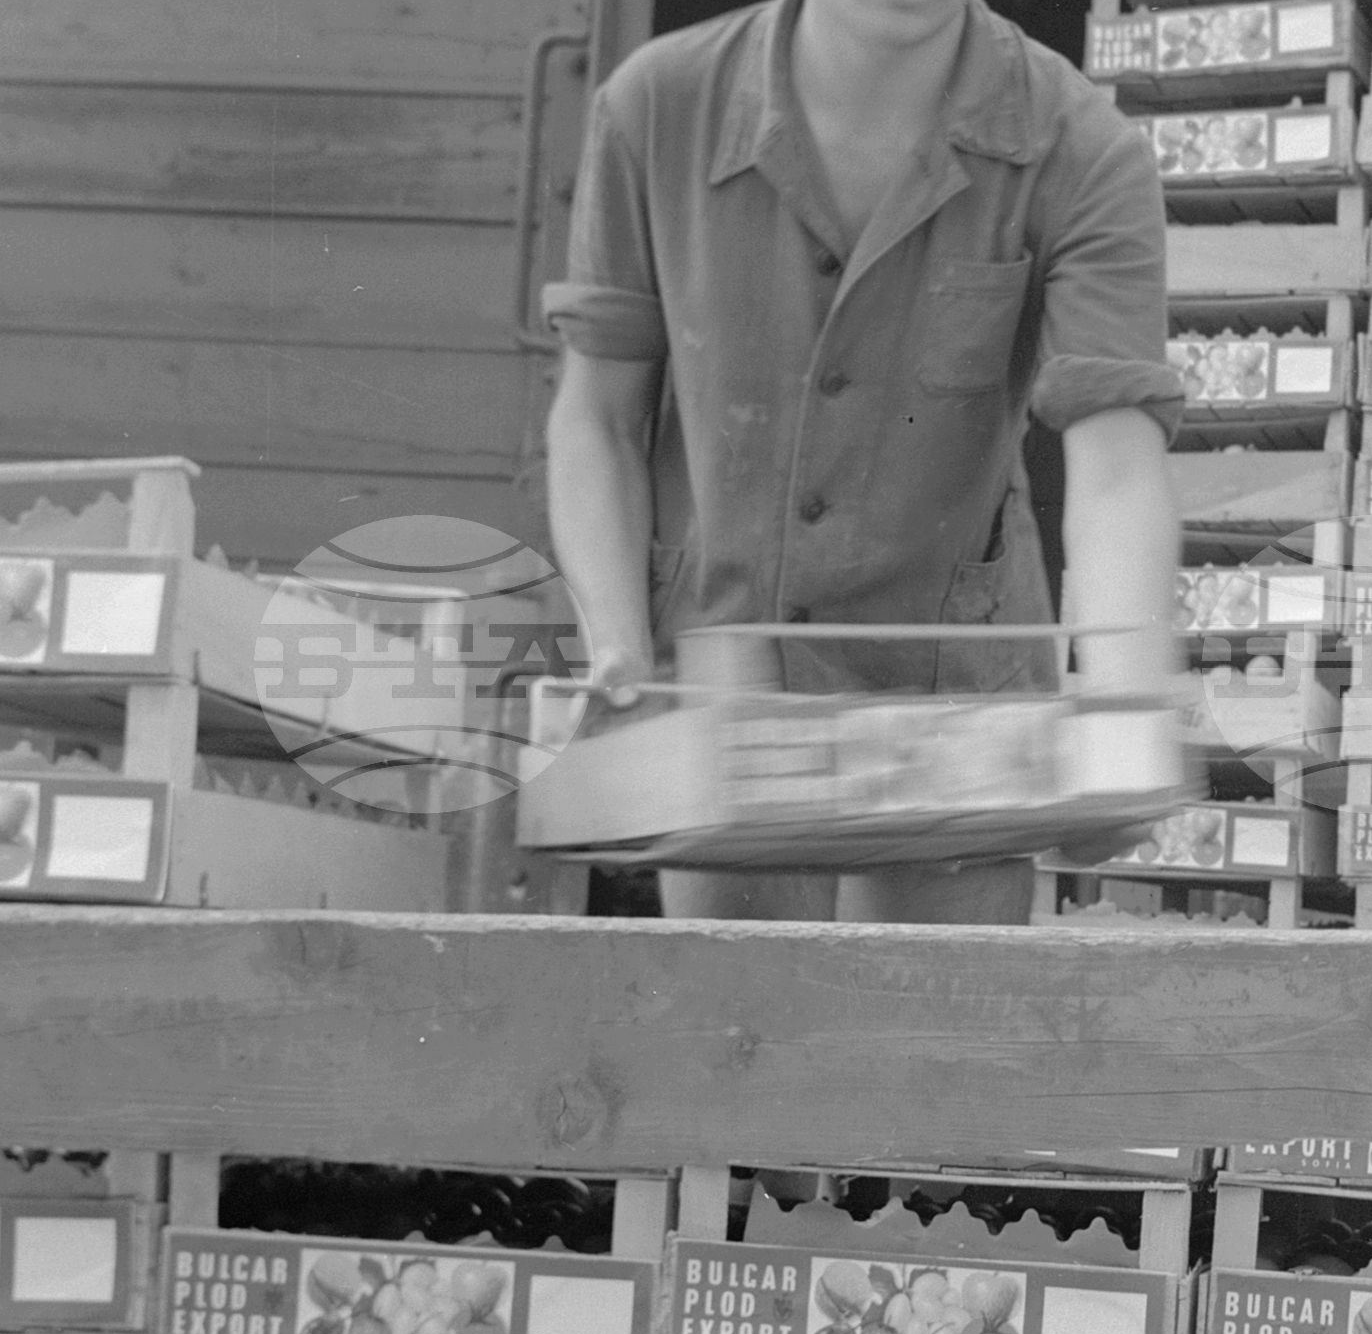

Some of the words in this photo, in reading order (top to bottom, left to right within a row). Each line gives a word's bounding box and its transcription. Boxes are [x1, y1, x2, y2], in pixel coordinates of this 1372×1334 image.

[686, 1258, 797, 1292] BULGAR
[174, 1279, 247, 1310] PLOD
[684, 1287, 756, 1318] PLOD
[1224, 1291, 1335, 1326] BULGAR
